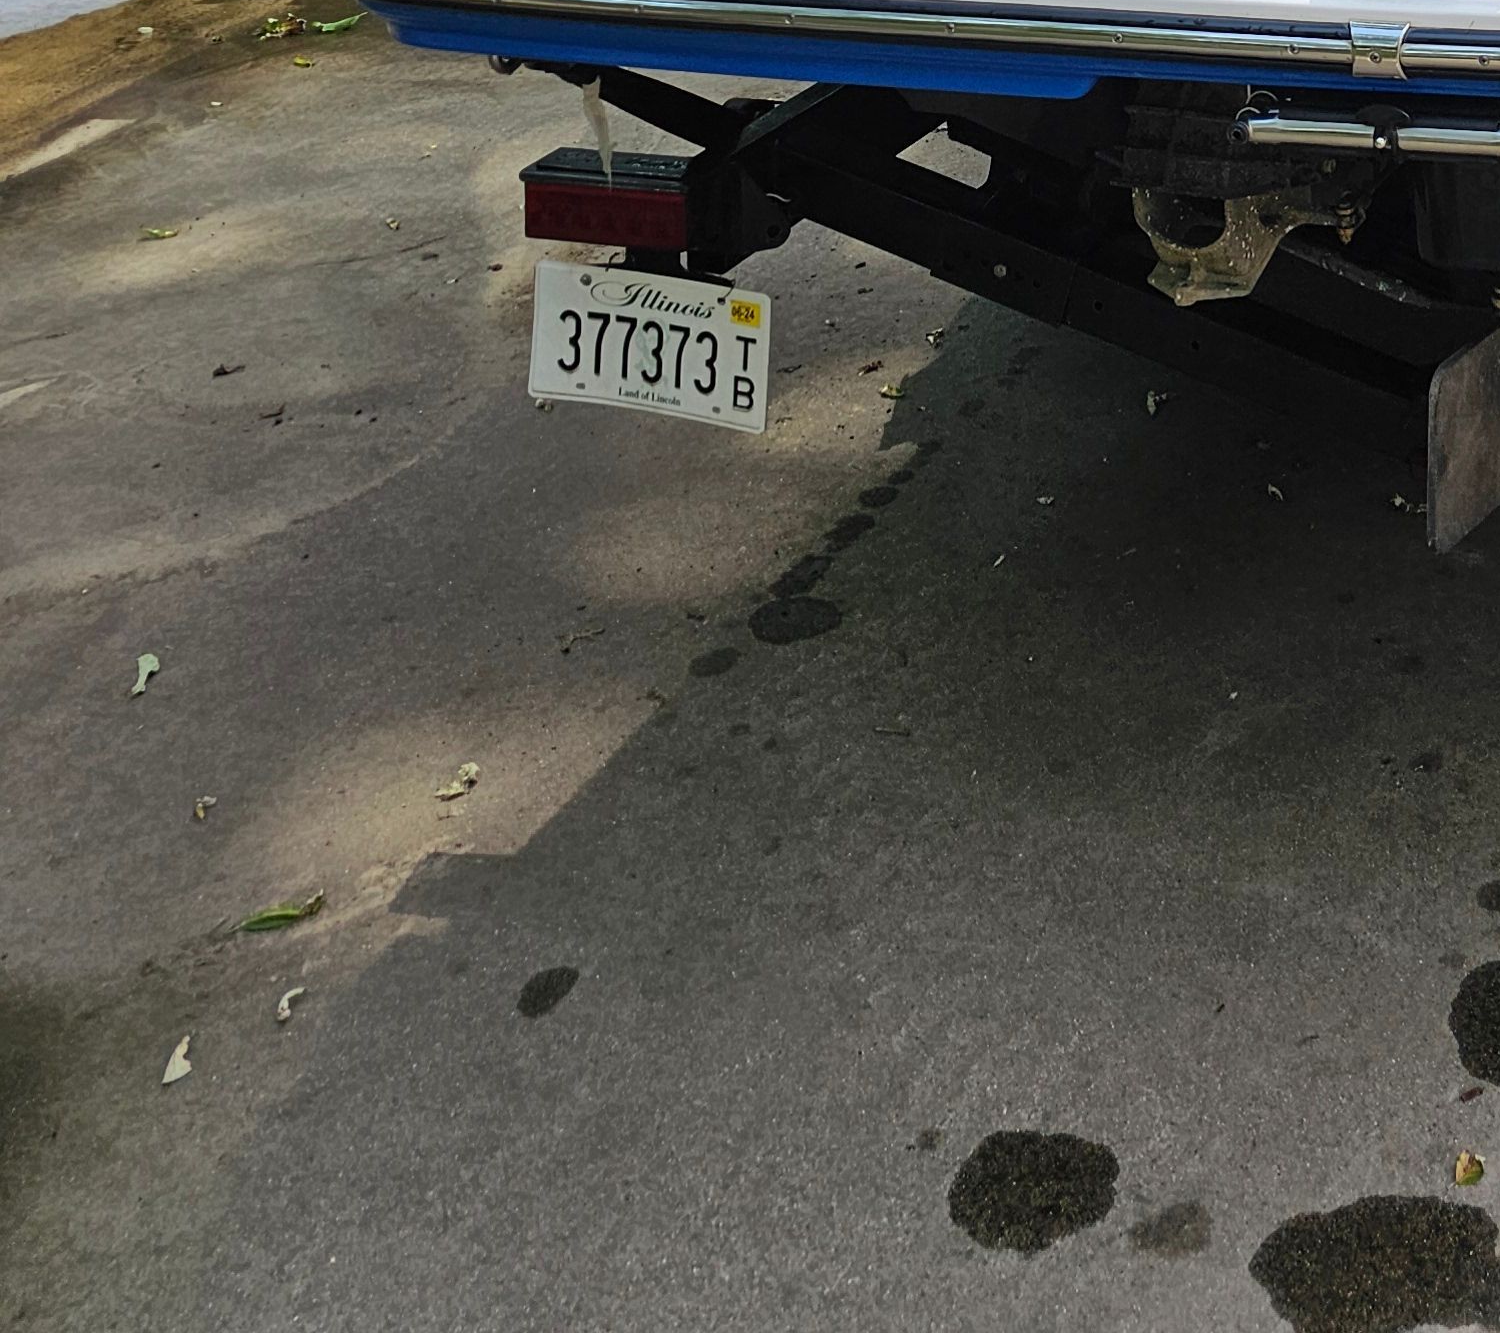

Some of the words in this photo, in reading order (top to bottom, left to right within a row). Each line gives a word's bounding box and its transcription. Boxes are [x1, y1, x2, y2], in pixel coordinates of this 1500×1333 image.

[590, 282, 715, 319] Illinois
[557, 309, 718, 395] 377373
[736, 335, 757, 372] T
[618, 386, 639, 400] Land
[641, 391, 650, 401] of
[651, 392, 681, 406] Lincoln
[732, 375, 755, 411] B
